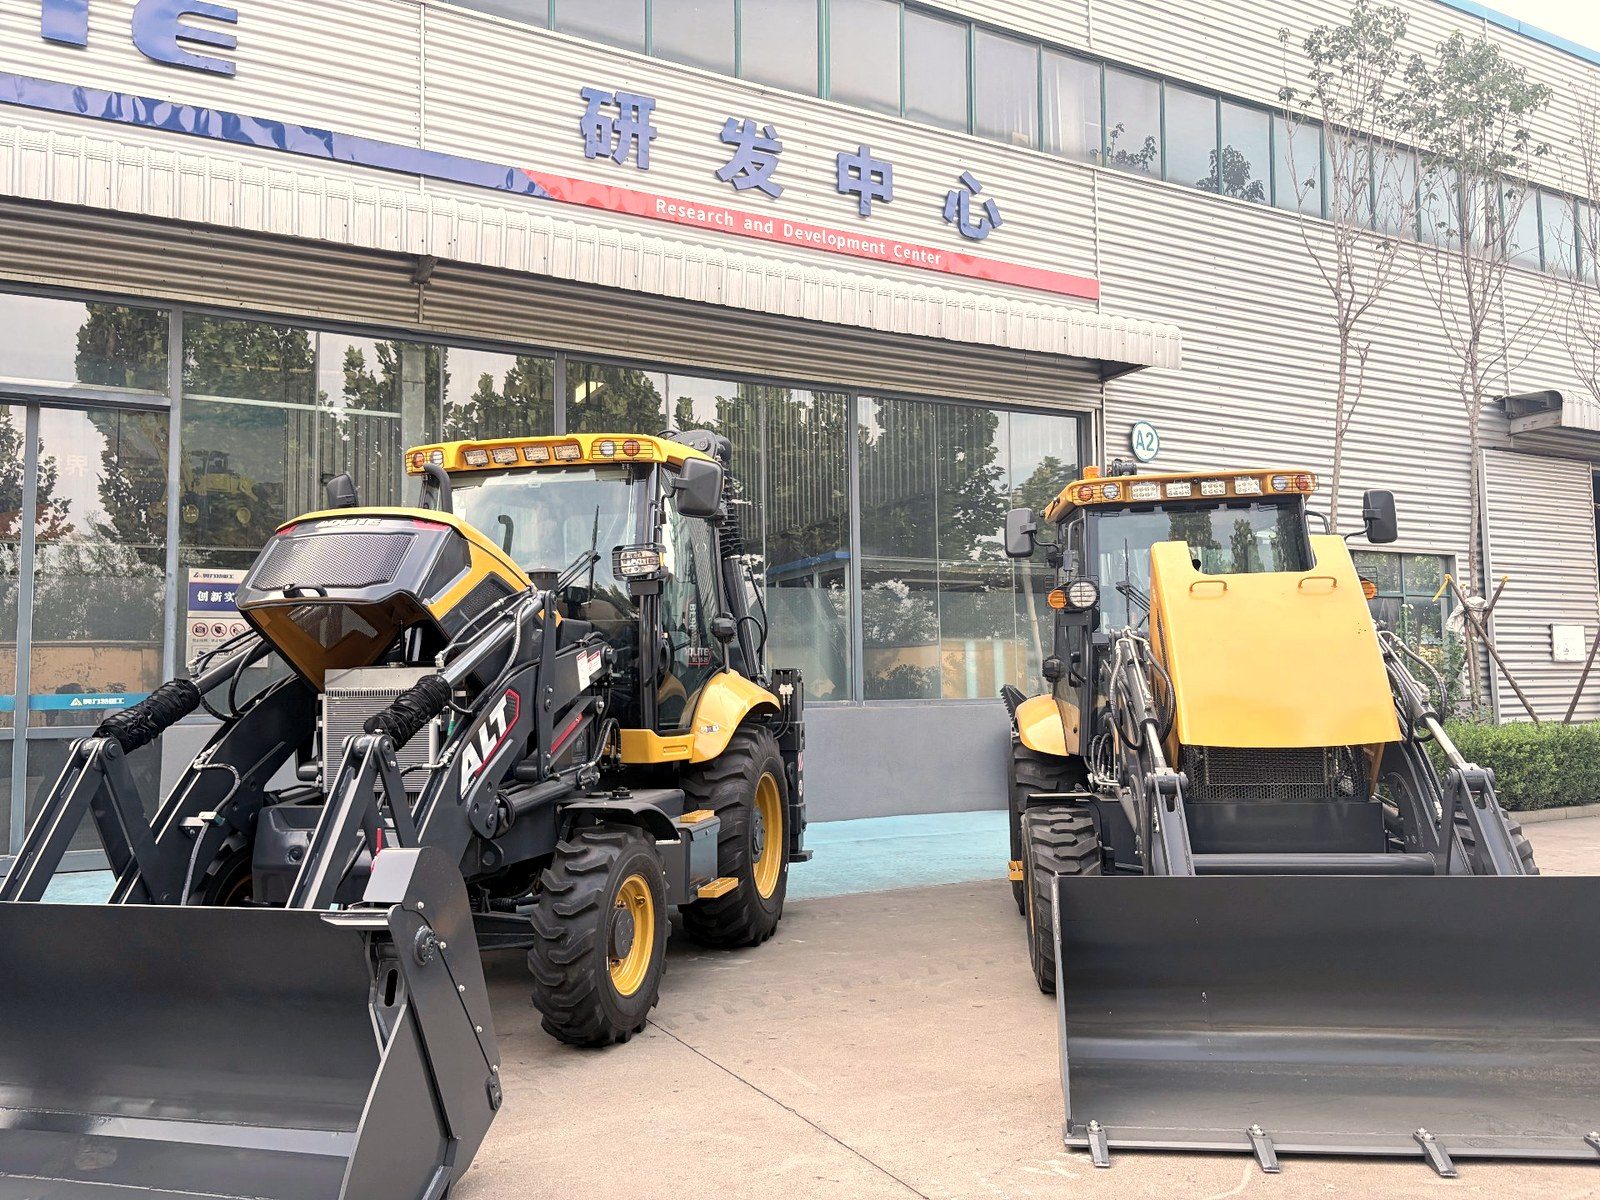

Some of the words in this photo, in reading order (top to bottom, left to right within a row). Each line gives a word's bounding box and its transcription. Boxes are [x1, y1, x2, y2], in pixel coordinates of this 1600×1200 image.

[580, 86, 1003, 242] 研发中心
[655, 198, 734, 227] Research
[743, 217, 774, 234] and
[783, 222, 886, 255] Development
[893, 244, 942, 265] Center
[1136, 430, 1155, 451] A2
[461, 694, 507, 797] ALT
